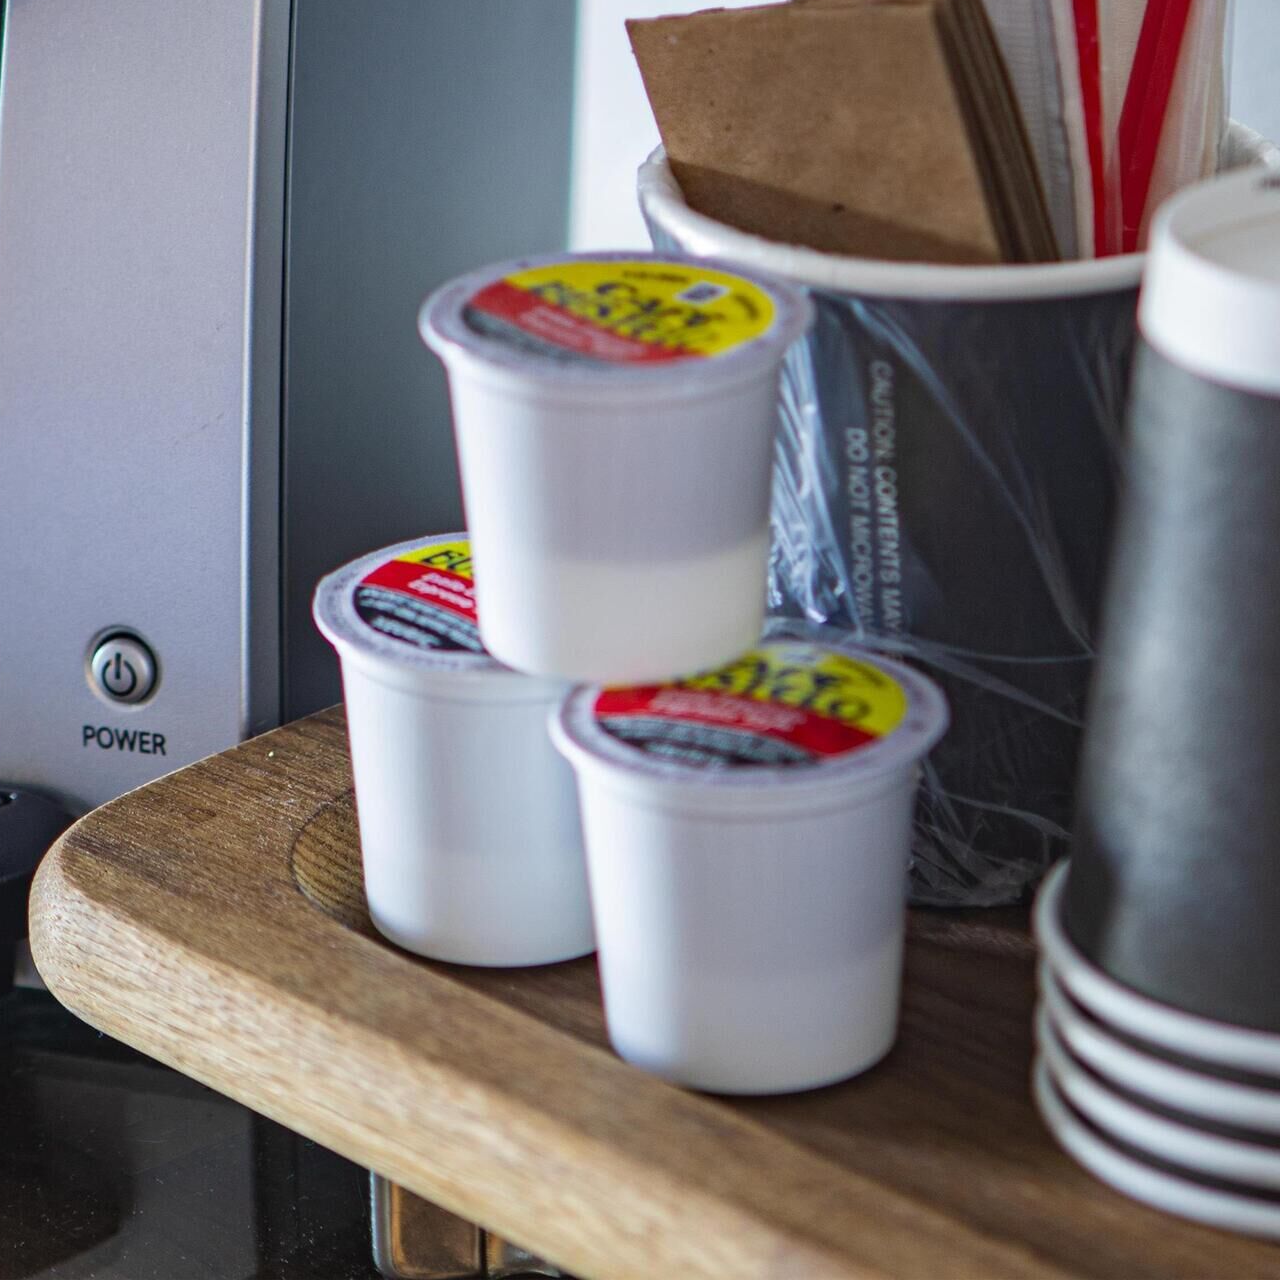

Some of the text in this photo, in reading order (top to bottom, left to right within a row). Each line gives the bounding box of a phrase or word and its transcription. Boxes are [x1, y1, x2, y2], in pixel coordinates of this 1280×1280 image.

[846, 426, 869, 462] DO
[848, 465, 871, 513] NOT
[874, 464, 901, 585] CONTENTS
[82, 724, 167, 756] POWER
